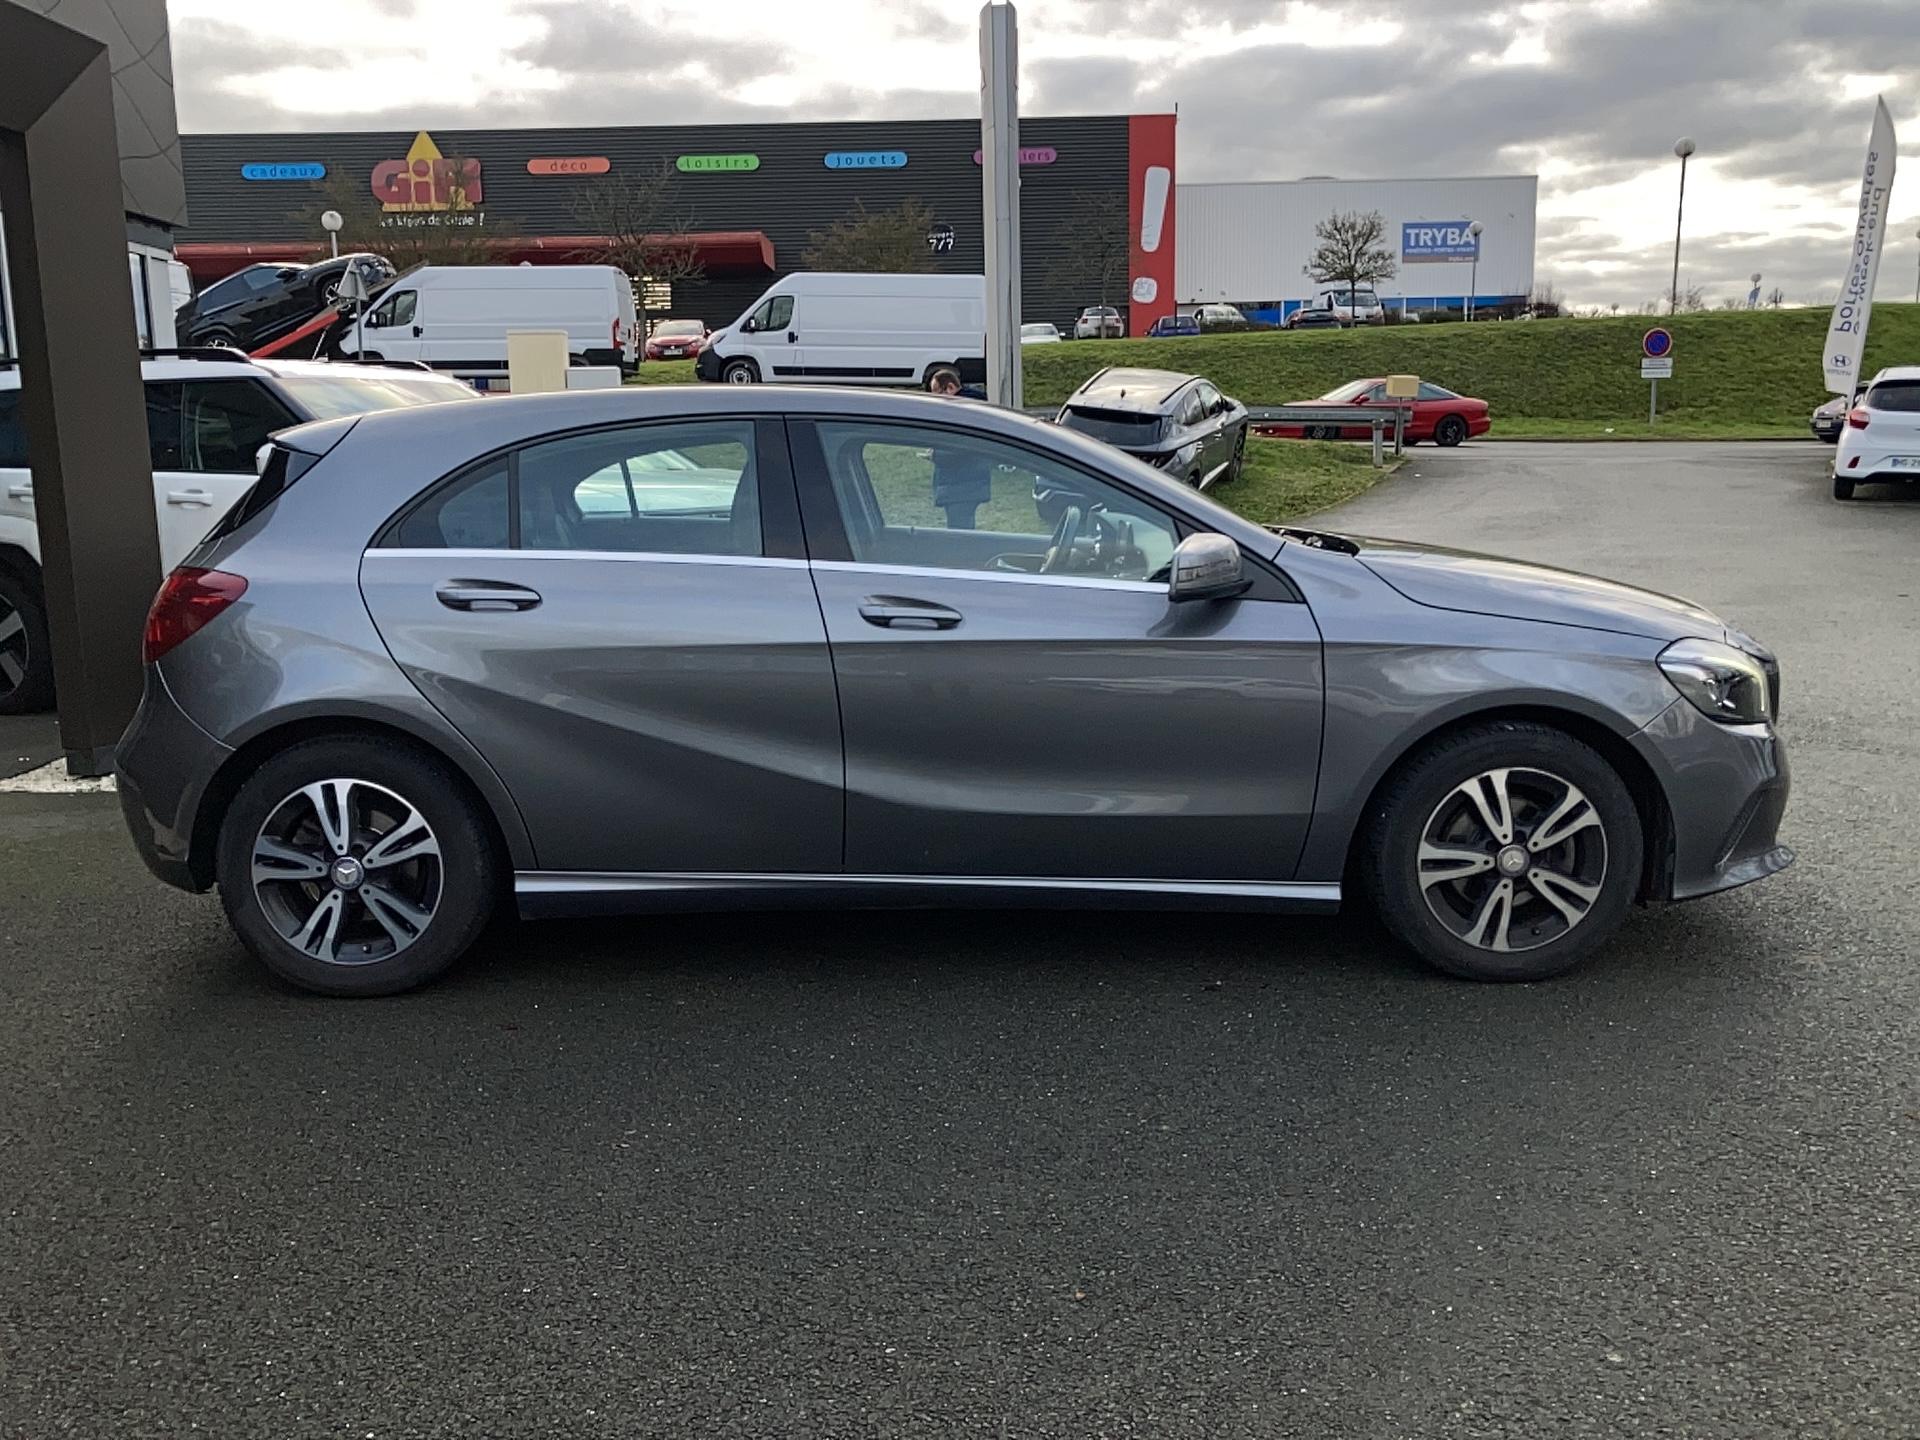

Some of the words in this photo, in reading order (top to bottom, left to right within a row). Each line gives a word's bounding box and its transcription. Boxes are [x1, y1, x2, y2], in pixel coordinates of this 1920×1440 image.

[550, 160, 587, 171] déco
[686, 157, 750, 168] loisirs
[836, 154, 897, 168] jouets
[250, 165, 317, 177] cadeaux
[1406, 227, 1476, 247] TRYBA
[929, 238, 954, 251] 7/7
